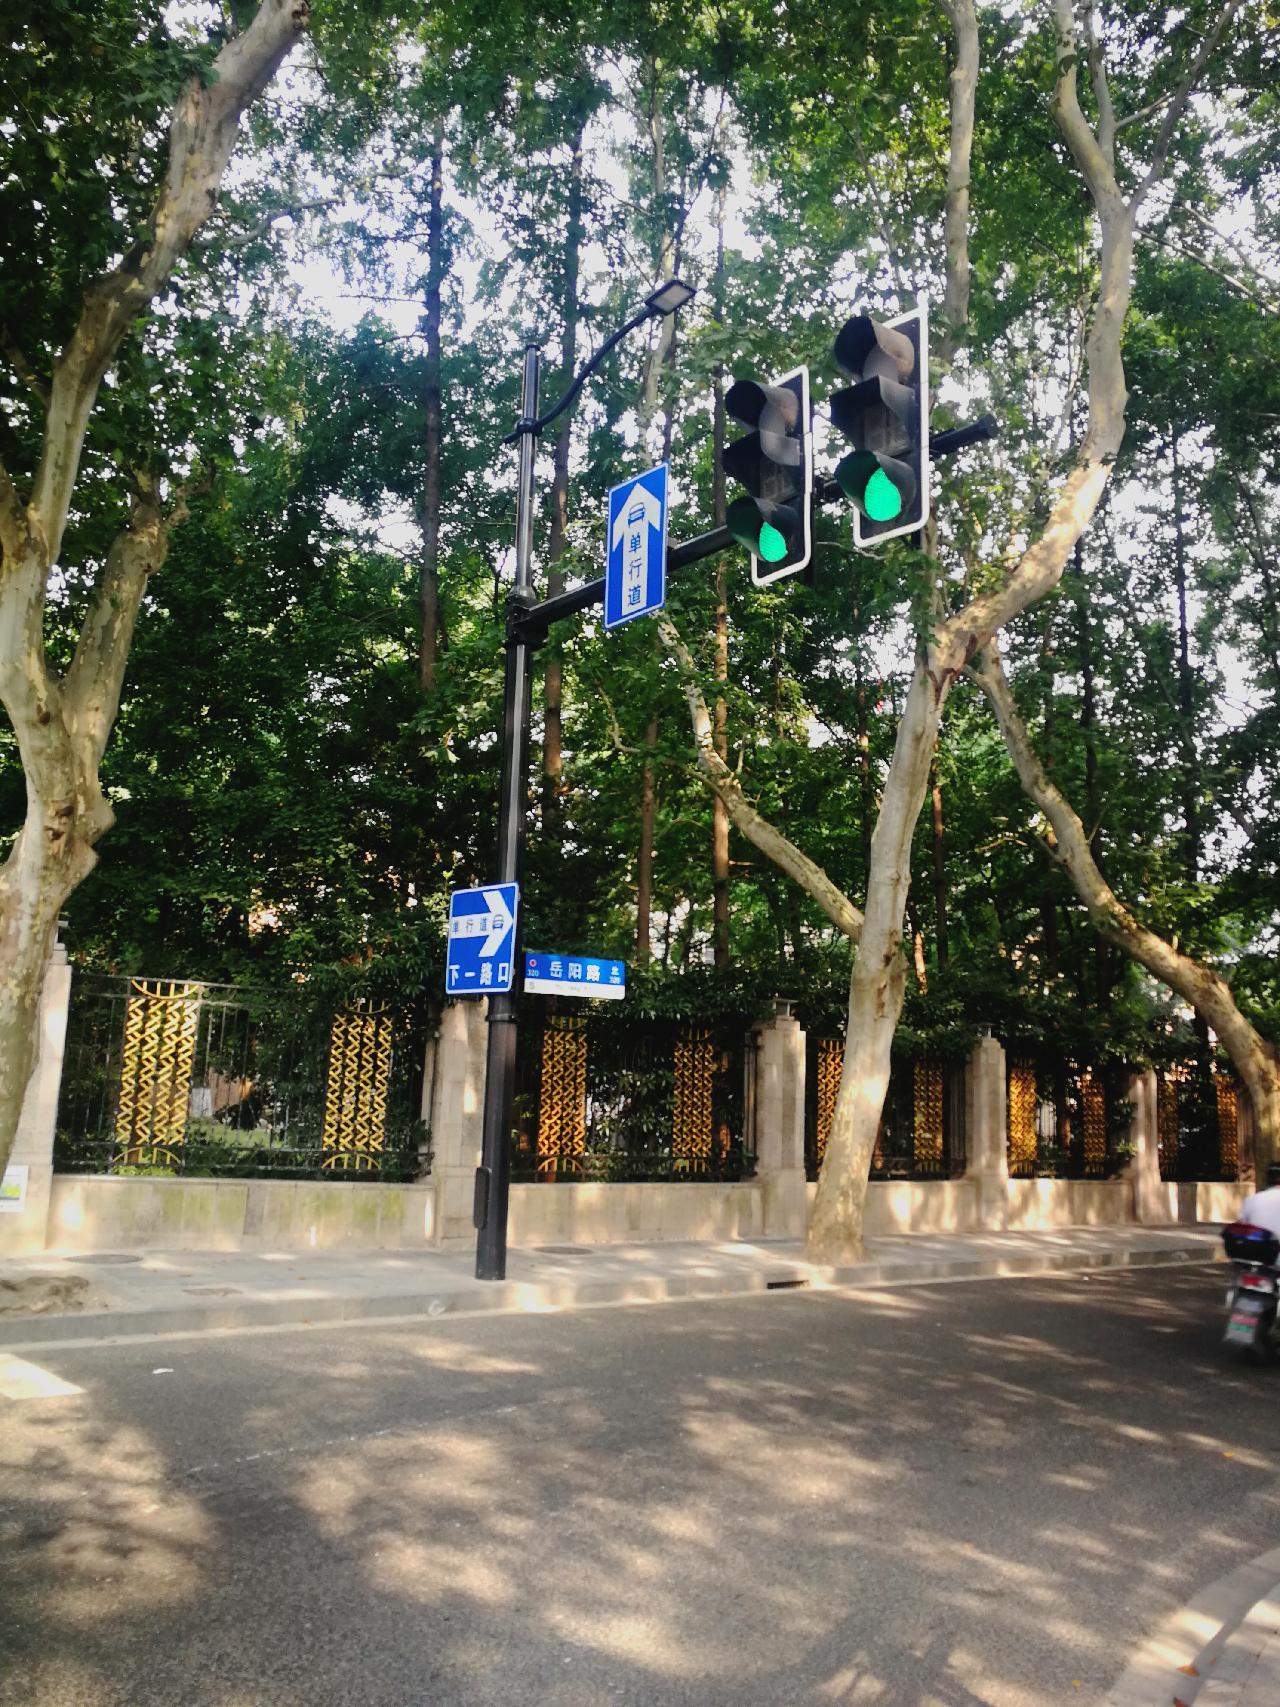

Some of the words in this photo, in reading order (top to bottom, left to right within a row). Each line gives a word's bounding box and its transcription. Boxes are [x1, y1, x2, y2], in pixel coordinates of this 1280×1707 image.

[628, 532, 643, 607] 单行道
[452, 917, 487, 933] 单行道
[449, 961, 509, 986] 下一路口
[549, 960, 601, 982] 岳阳路
